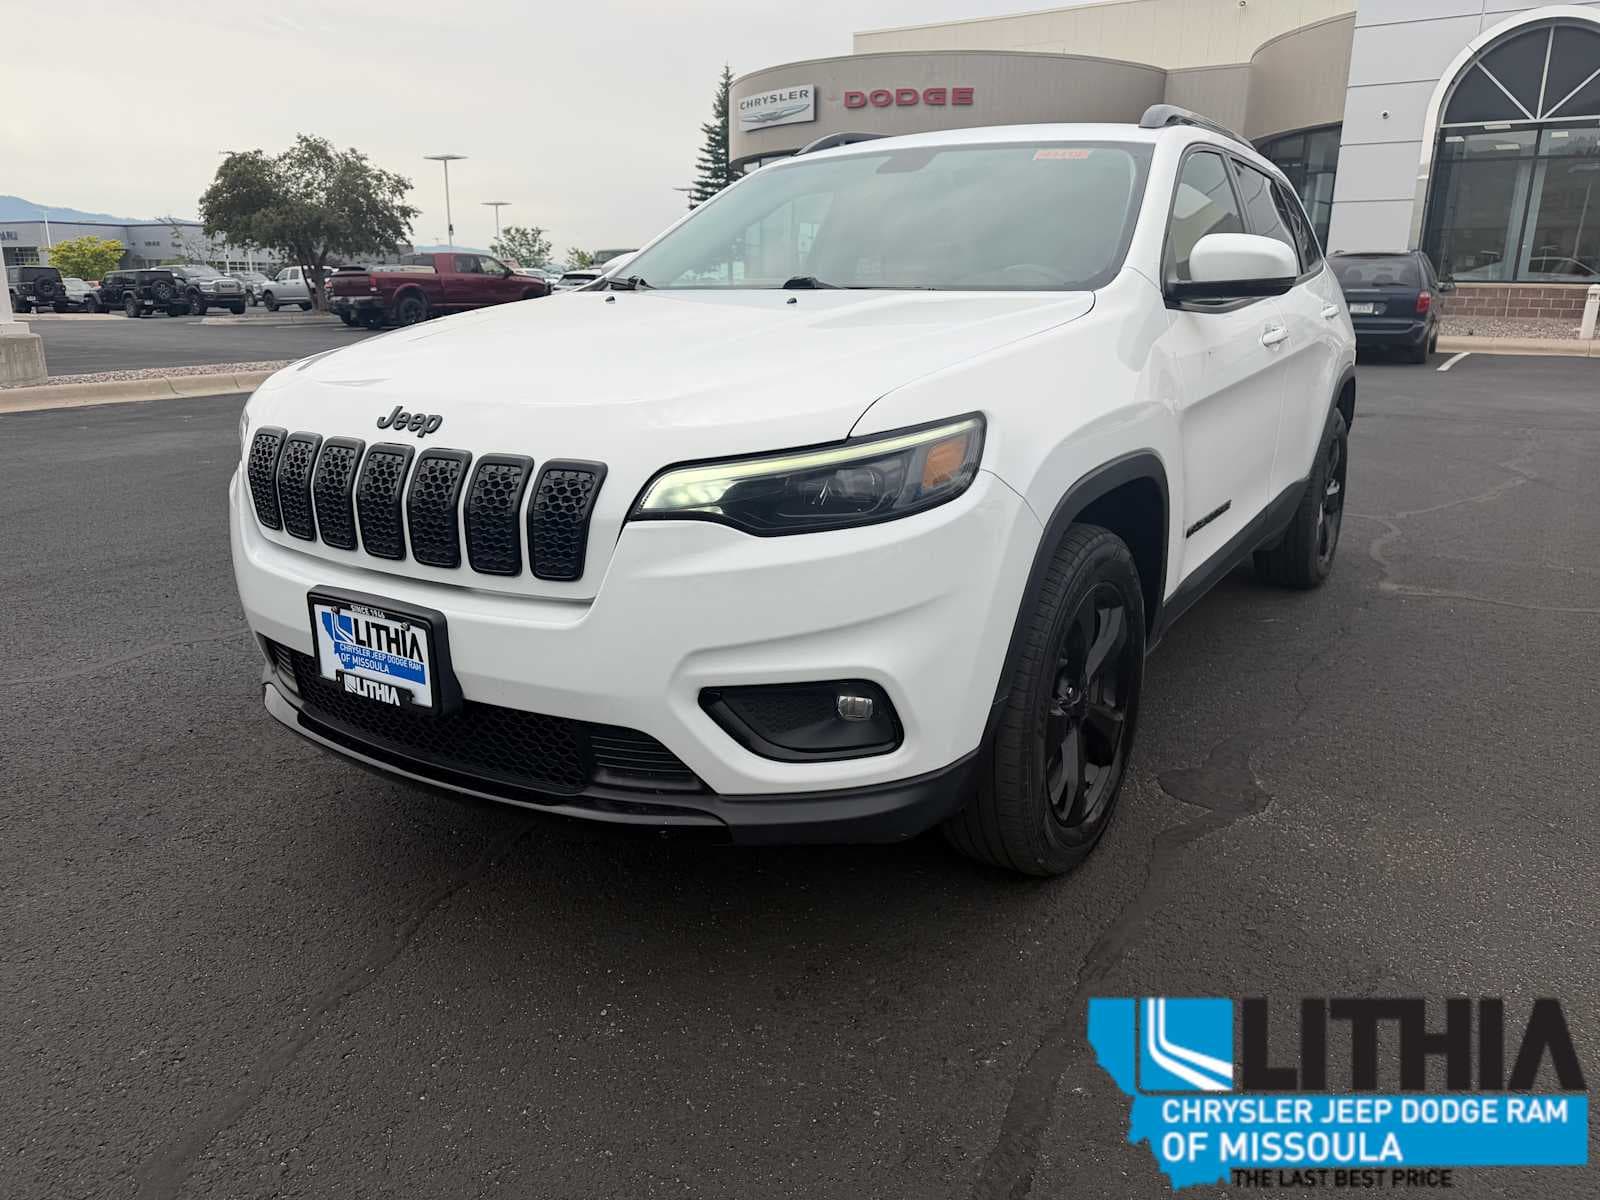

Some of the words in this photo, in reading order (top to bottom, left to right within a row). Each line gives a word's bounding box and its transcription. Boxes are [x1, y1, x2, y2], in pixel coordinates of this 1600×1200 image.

[739, 89, 809, 111] CHRYSLER
[843, 87, 974, 109] DODGE
[377, 405, 443, 438] Jeep
[350, 604, 369, 616] SINCE
[353, 617, 424, 664] LITHIA
[340, 643, 370, 657] CHRYSLER
[371, 651, 386, 661] JEEP
[387, 655, 408, 668] DODGE
[408, 661, 422, 672] RAM
[341, 652, 351, 663] OF
[352, 655, 390, 673] MISSOULA
[356, 677, 400, 706] LITHIA
